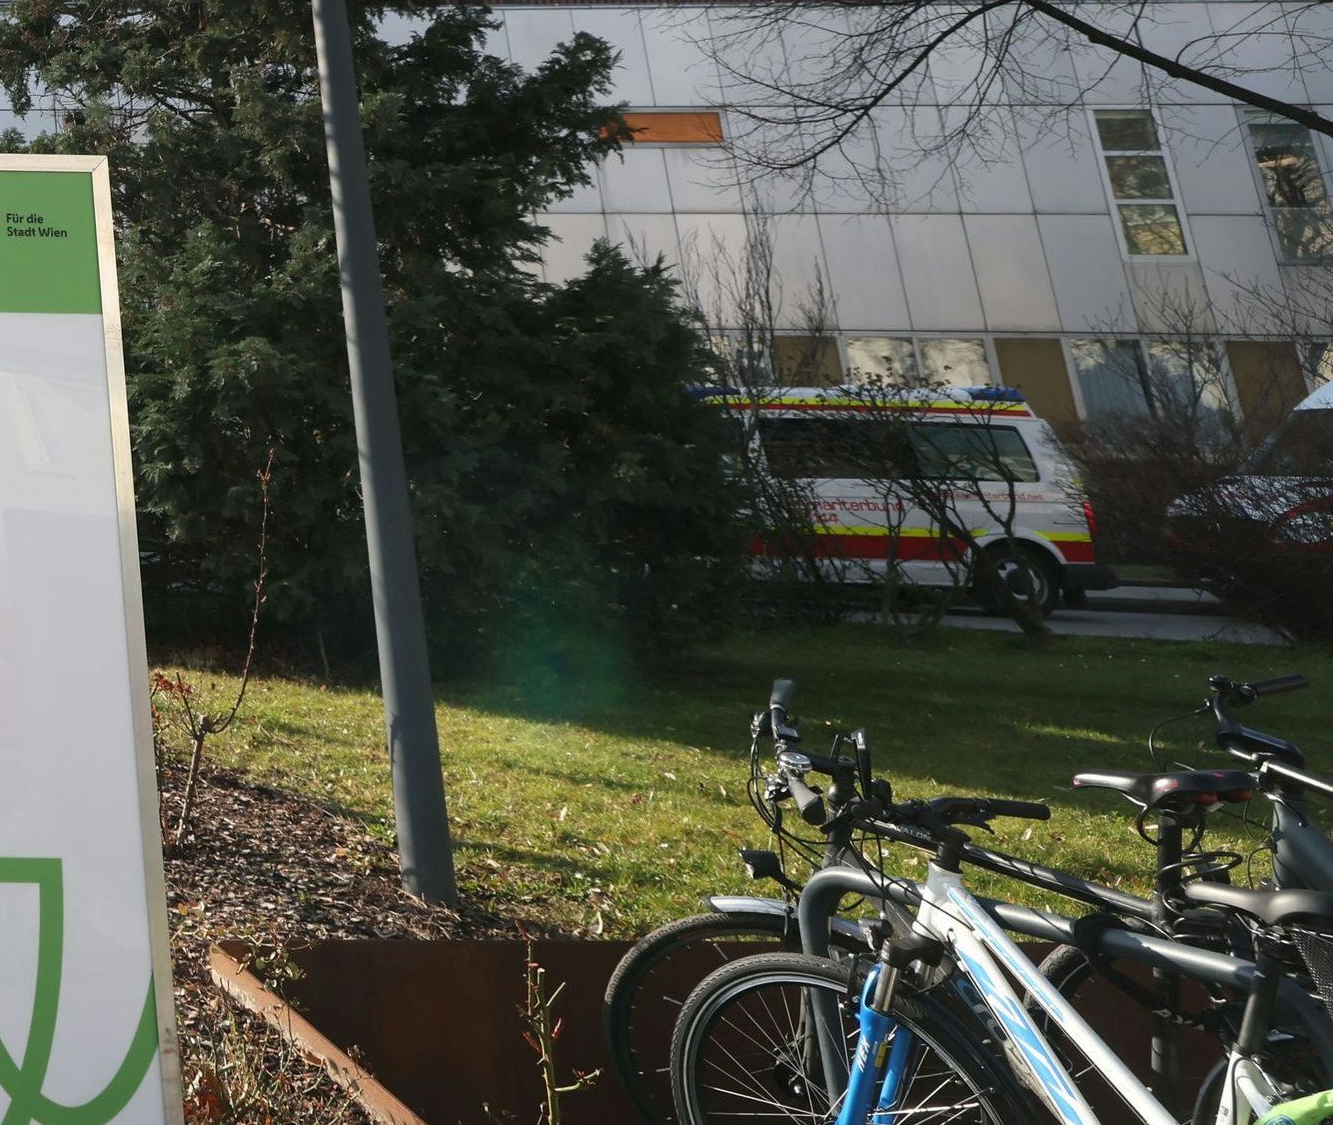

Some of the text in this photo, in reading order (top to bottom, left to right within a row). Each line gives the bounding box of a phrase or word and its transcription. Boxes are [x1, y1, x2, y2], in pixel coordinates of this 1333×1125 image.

[6, 213, 43, 223] Für die
[7, 227, 67, 237] Stadt Wien
